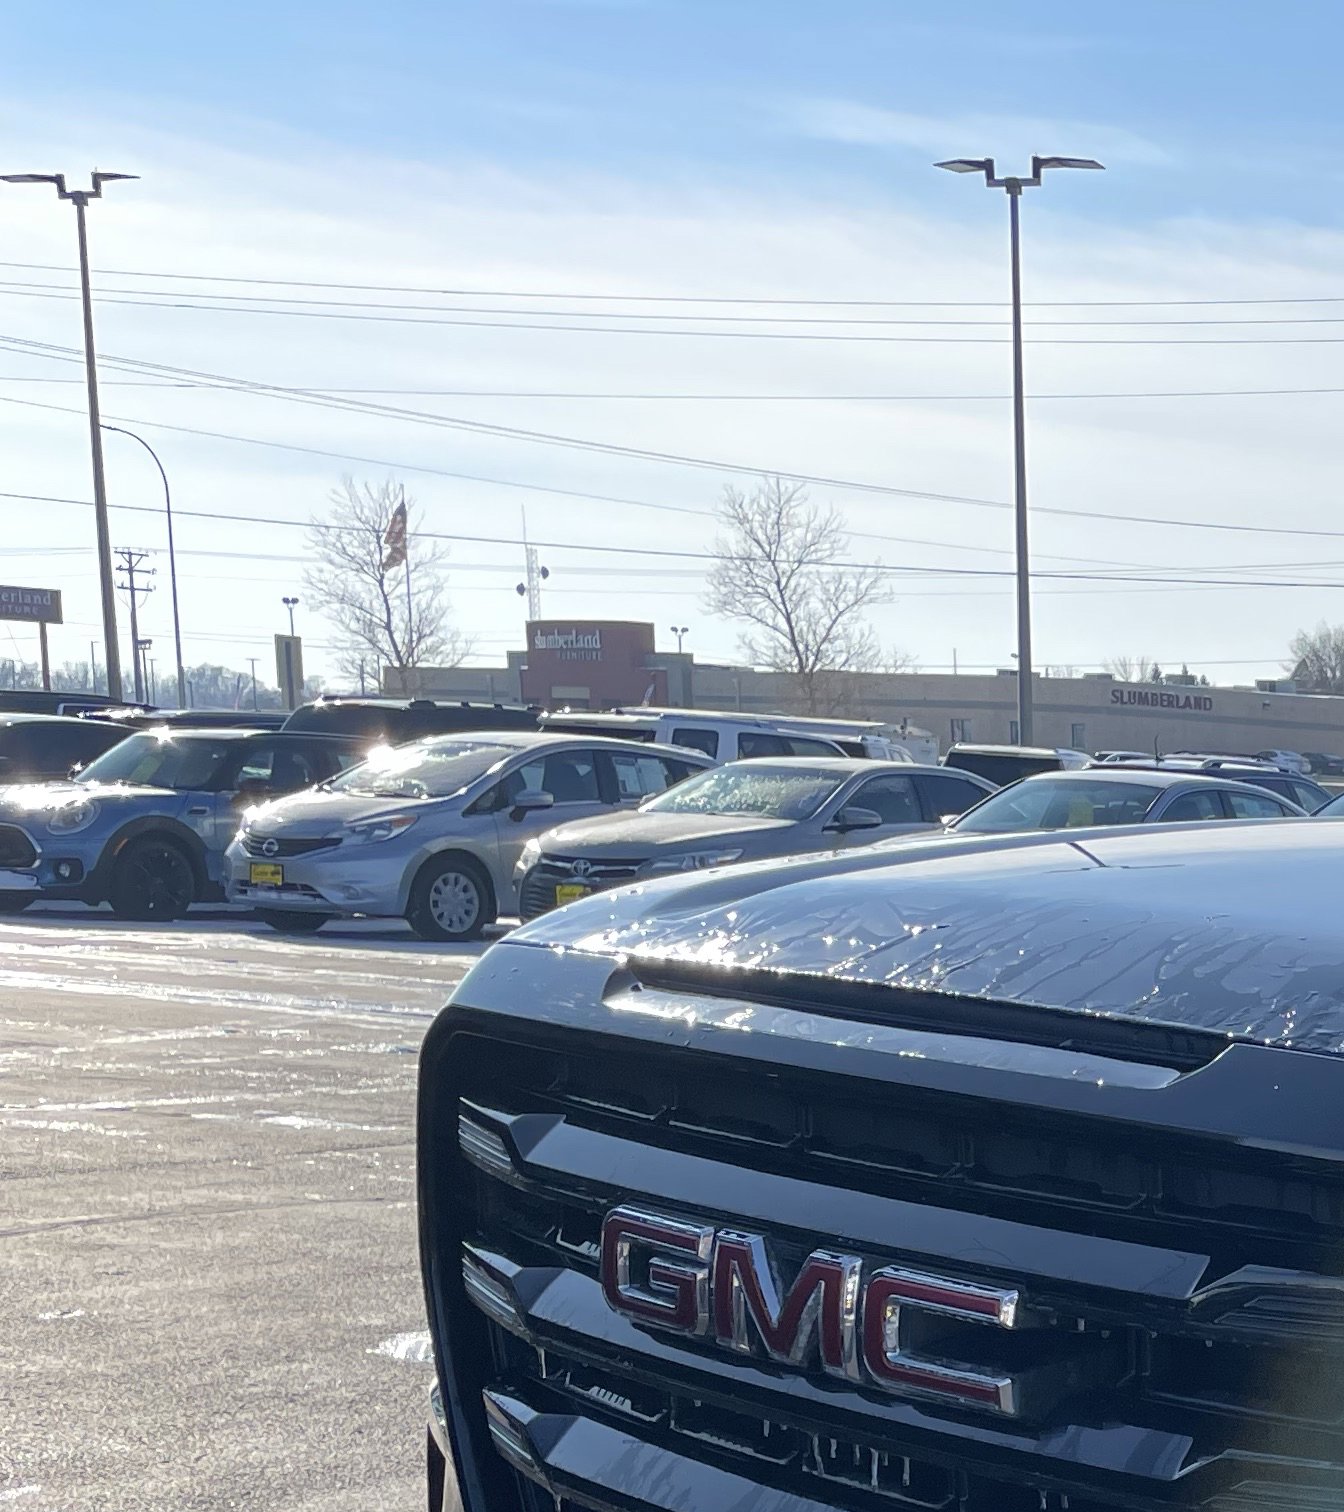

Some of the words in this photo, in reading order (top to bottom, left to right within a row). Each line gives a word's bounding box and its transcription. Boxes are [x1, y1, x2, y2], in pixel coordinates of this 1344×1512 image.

[0, 590, 51, 605] erland
[1110, 689, 1213, 712] SLUMBERLAND
[600, 1204, 1020, 1416] GMC
